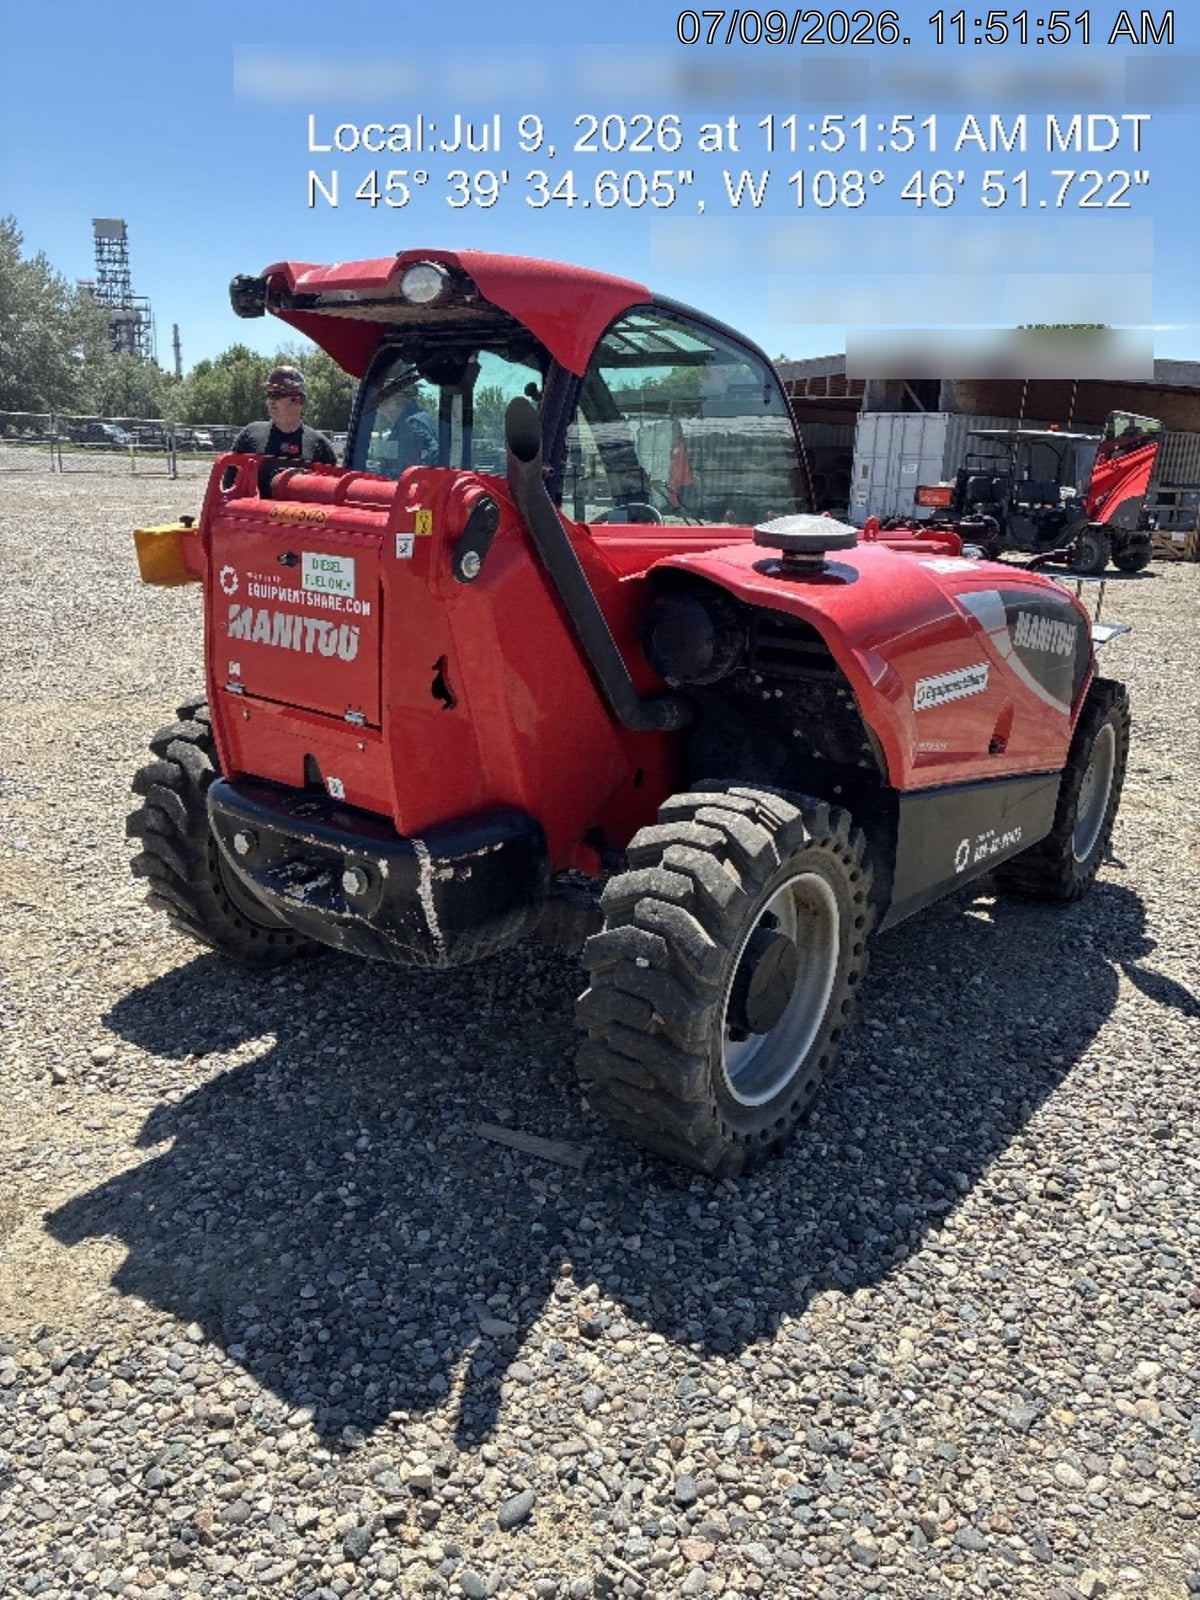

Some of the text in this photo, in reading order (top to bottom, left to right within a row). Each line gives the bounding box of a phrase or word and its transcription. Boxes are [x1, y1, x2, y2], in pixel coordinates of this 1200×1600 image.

[312, 557, 343, 573] DIESEL
[305, 573, 352, 591] FUEL ONLY
[247, 583, 371, 616] EQUIPMENTSHARE.COM
[227, 604, 360, 662] MANITOU
[1013, 611, 1077, 657] MANITOU
